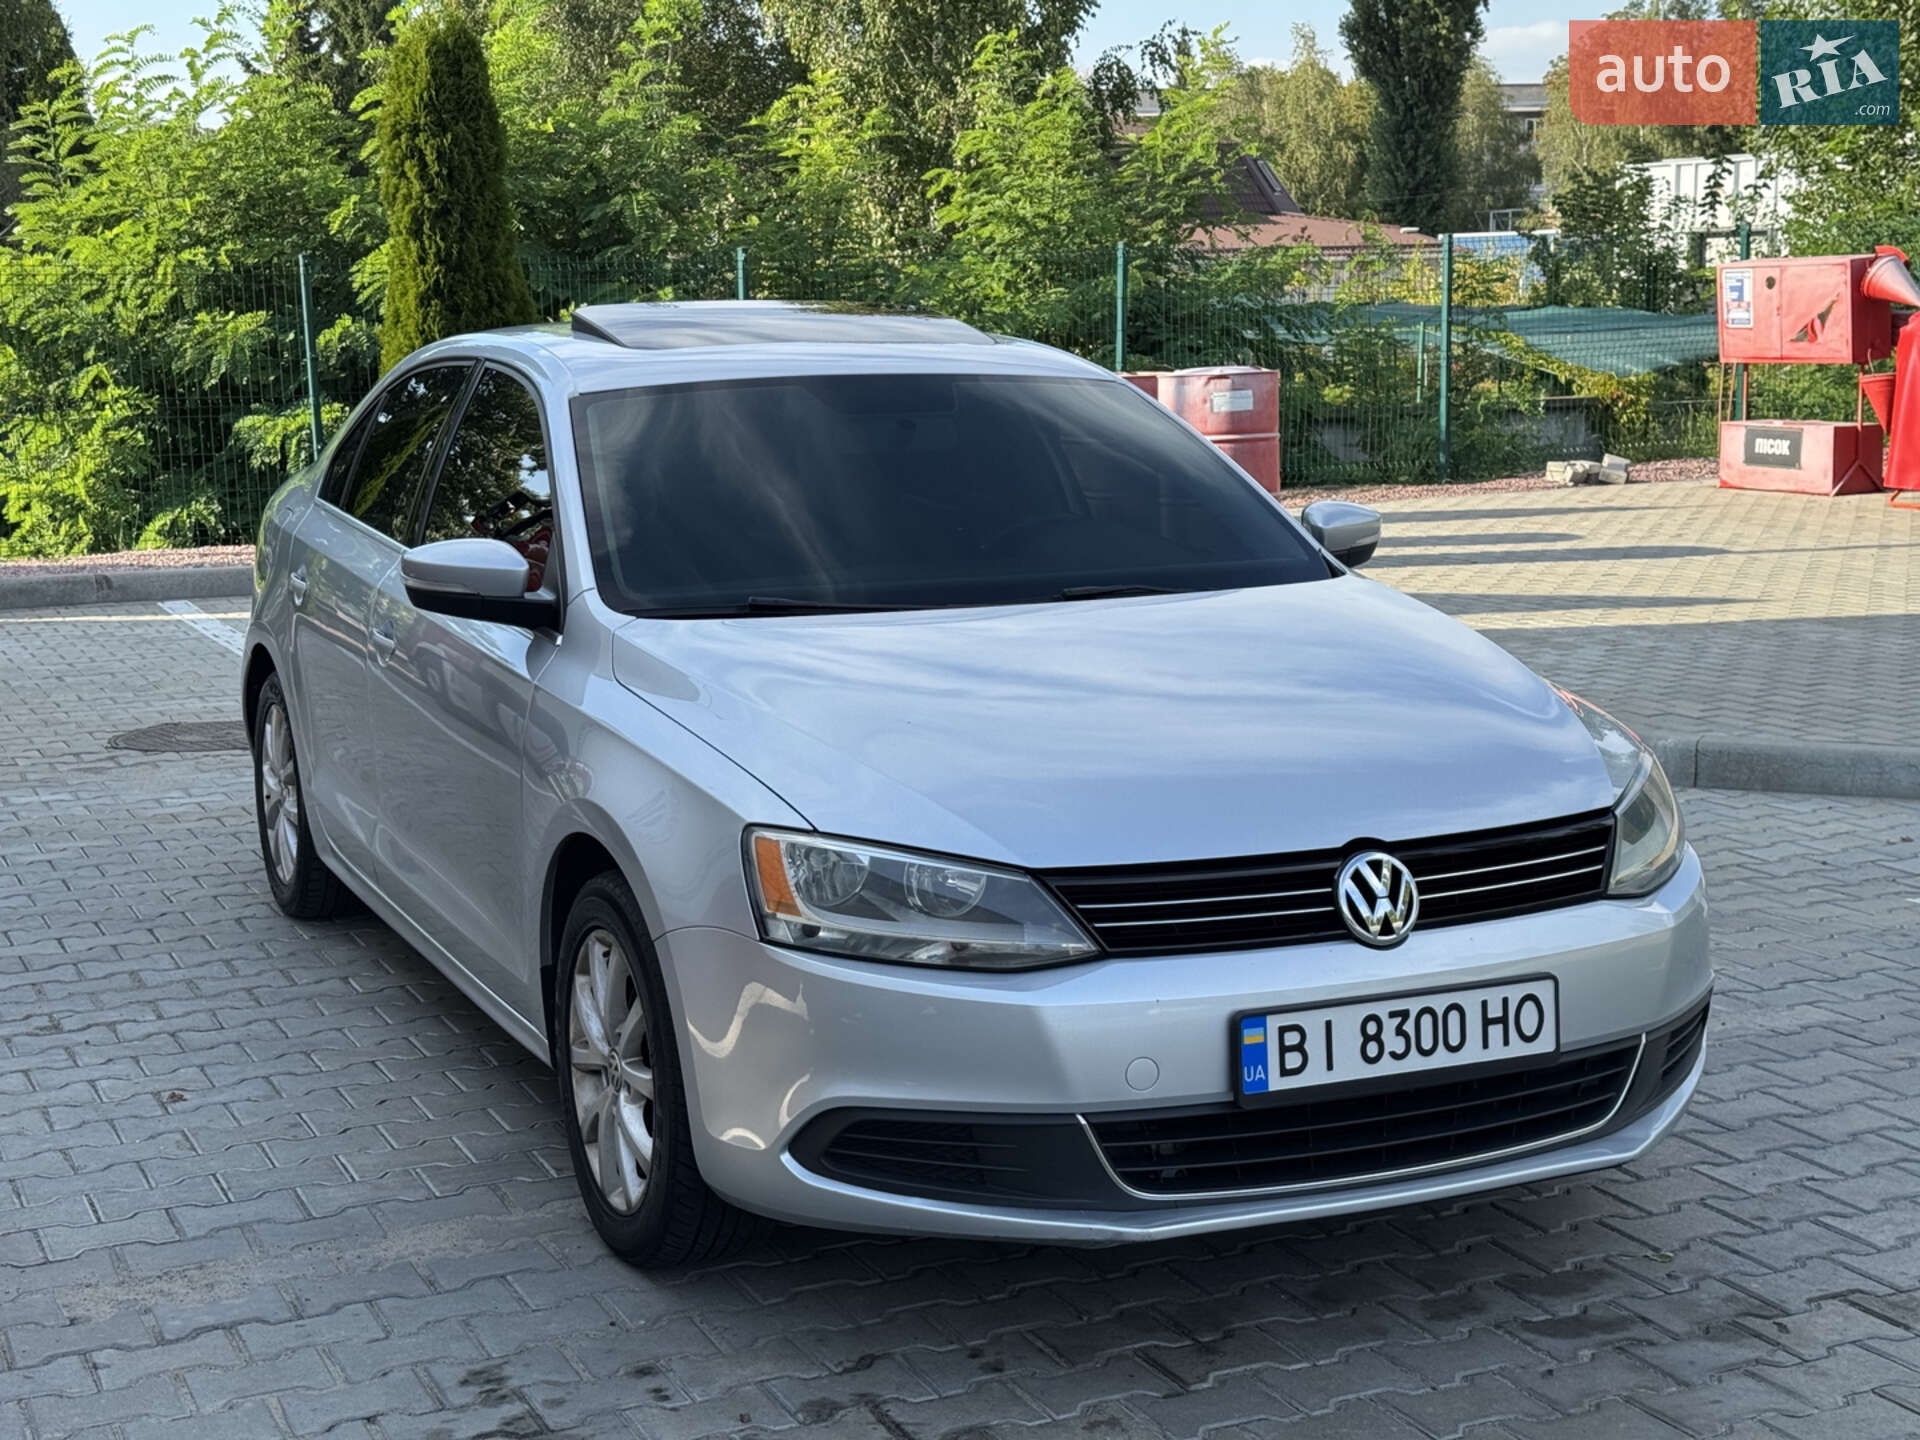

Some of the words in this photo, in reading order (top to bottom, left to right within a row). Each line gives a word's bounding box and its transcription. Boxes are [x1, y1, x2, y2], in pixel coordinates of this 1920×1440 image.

[1360, 1002, 1467, 1065] 8300
[1481, 992, 1545, 1050] HO
[1244, 1063, 1266, 1082] UA
